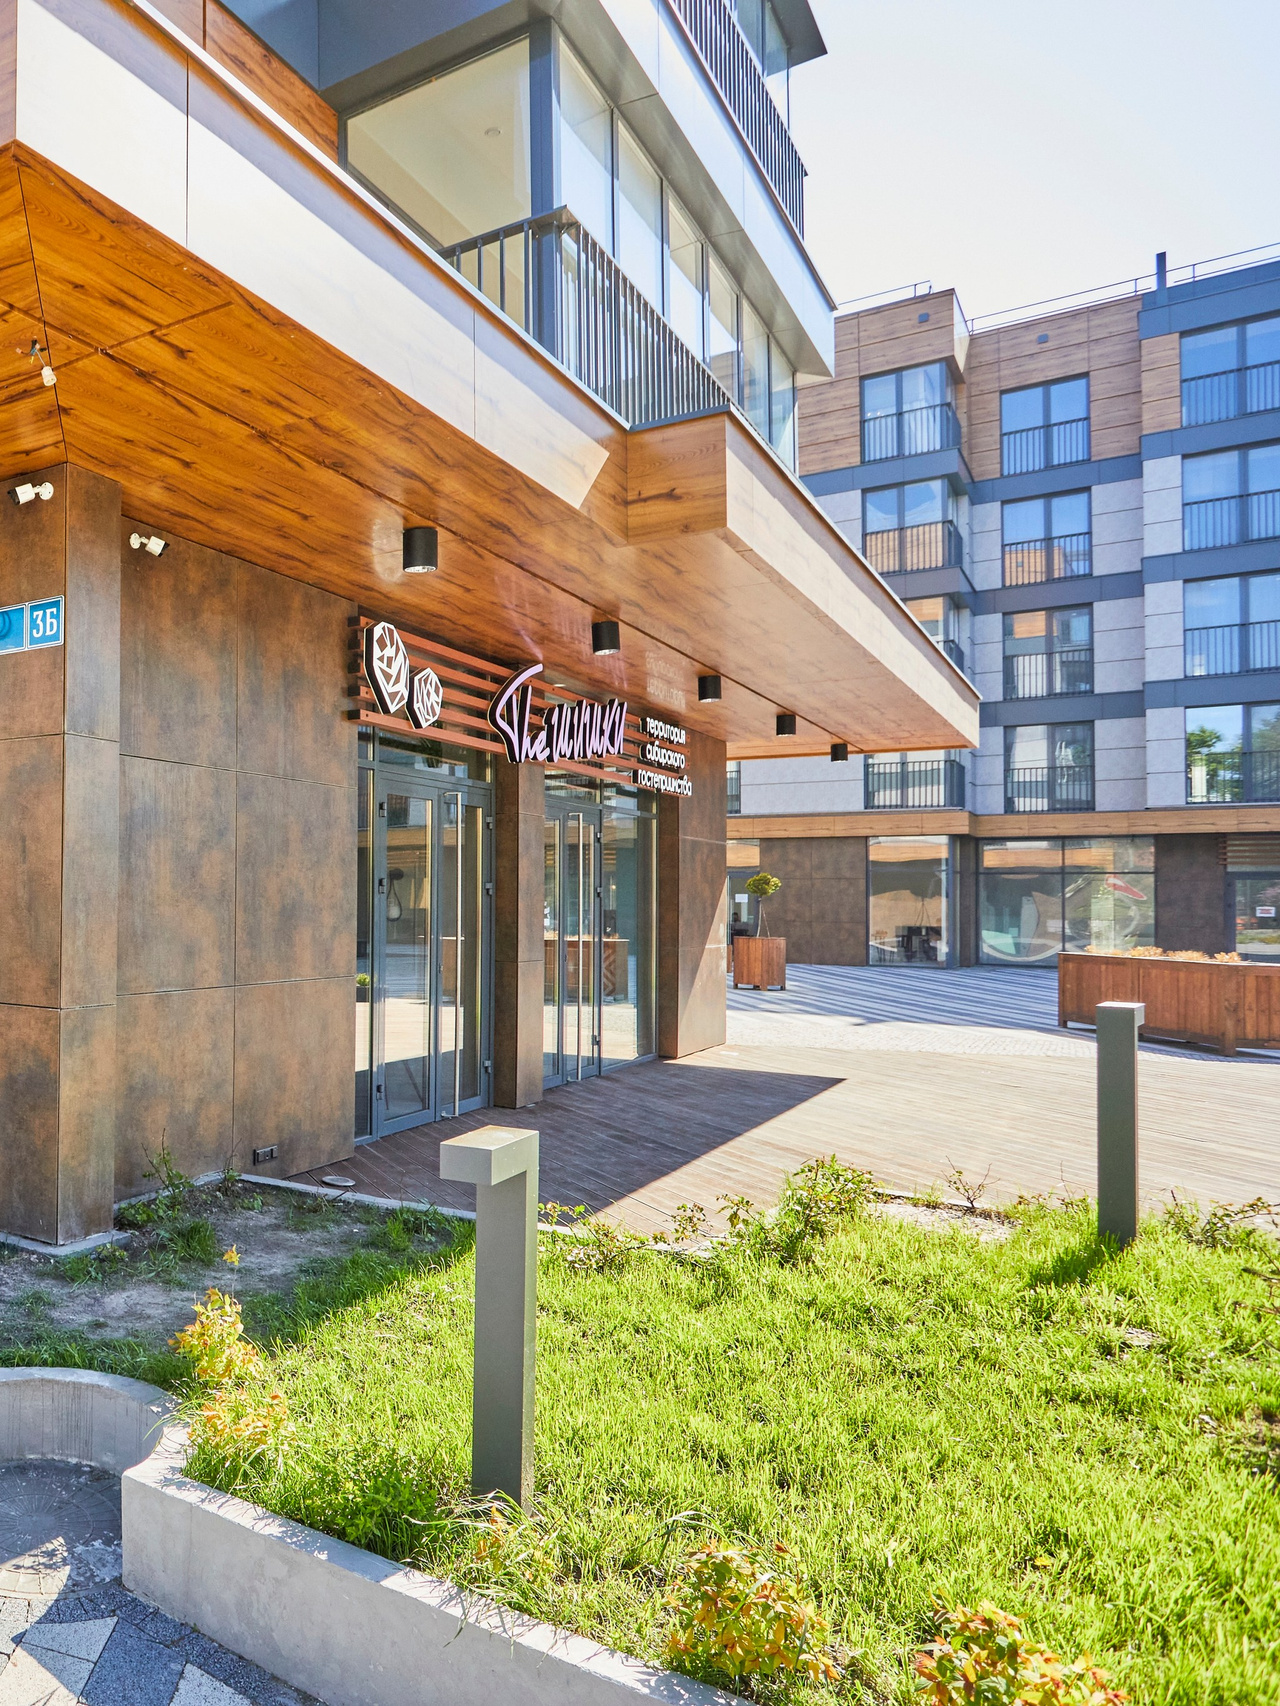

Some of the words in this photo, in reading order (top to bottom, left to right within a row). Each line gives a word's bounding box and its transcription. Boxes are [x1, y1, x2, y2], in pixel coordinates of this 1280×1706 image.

[32, 607, 58, 638] 3Б
[646, 717, 686, 744] территория
[646, 740, 686, 769] сибирского
[637, 768, 692, 796] гостеприимства
